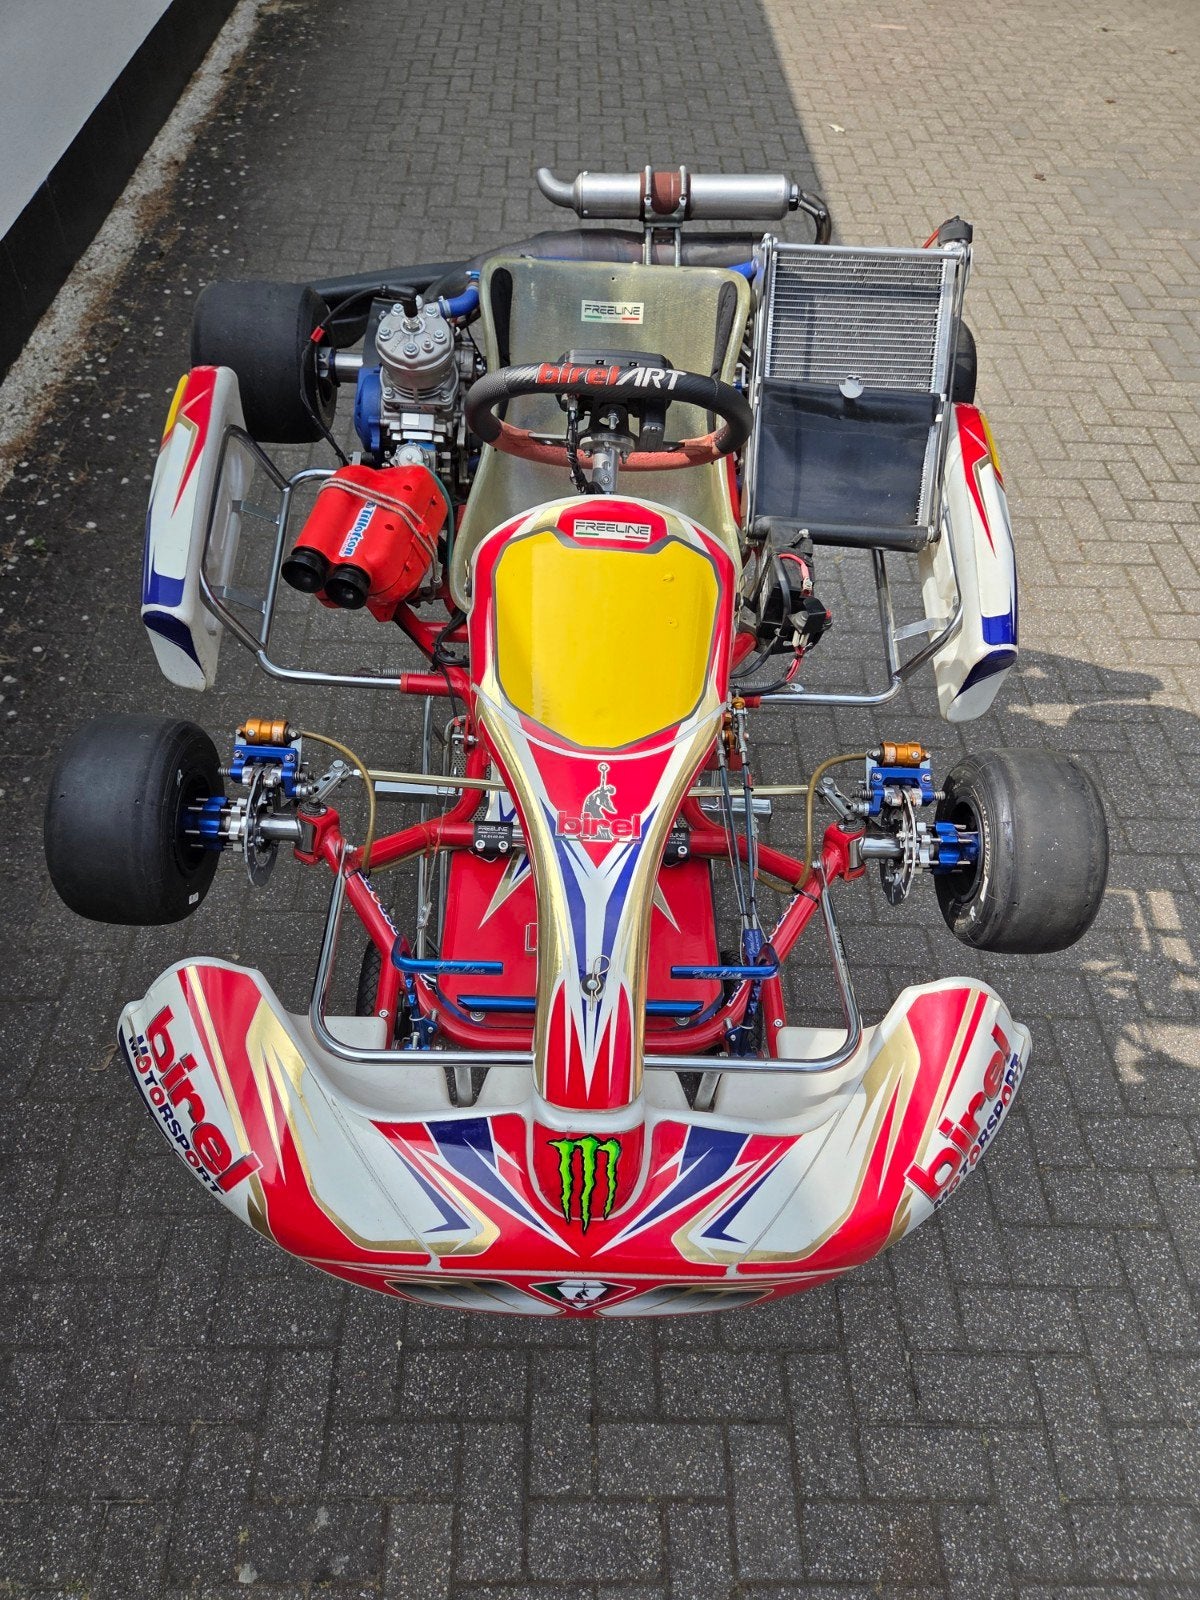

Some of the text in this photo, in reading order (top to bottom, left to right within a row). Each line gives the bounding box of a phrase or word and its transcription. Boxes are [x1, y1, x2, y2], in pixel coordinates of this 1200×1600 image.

[584, 304, 641, 316] FREELINE
[343, 509, 374, 555] Tillotson
[575, 521, 650, 535] FREELINE
[555, 811, 642, 839] birel
[128, 1034, 224, 1196] MOTORSPORT
[145, 1005, 264, 1193] birel
[904, 1023, 1012, 1201] birel
[933, 1053, 1019, 1210] MOTORSPORT
